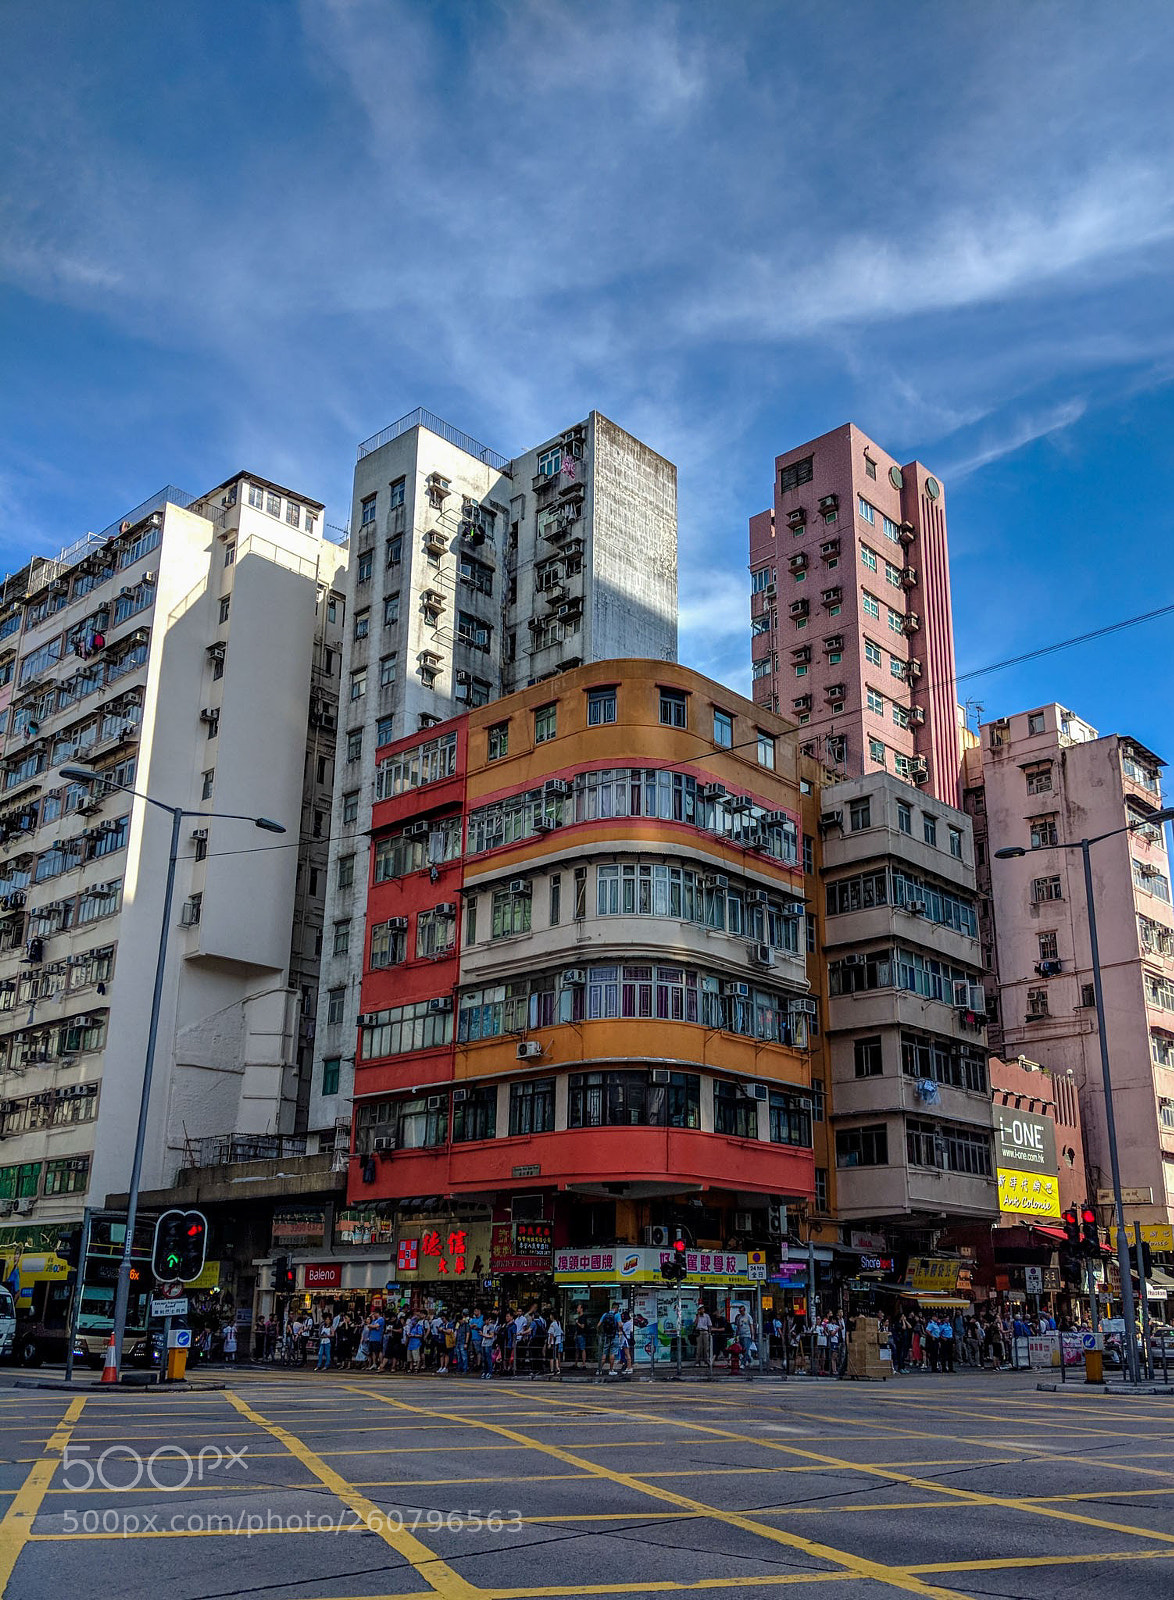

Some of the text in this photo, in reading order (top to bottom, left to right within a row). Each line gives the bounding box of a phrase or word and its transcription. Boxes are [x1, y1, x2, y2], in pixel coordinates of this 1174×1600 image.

[1000, 1116, 1044, 1149] i-ONE
[1002, 1148, 1045, 1163] www.i-one.com.hk
[557, 1254, 613, 1270] 換領中國牌
[309, 1268, 336, 1281] Baleno
